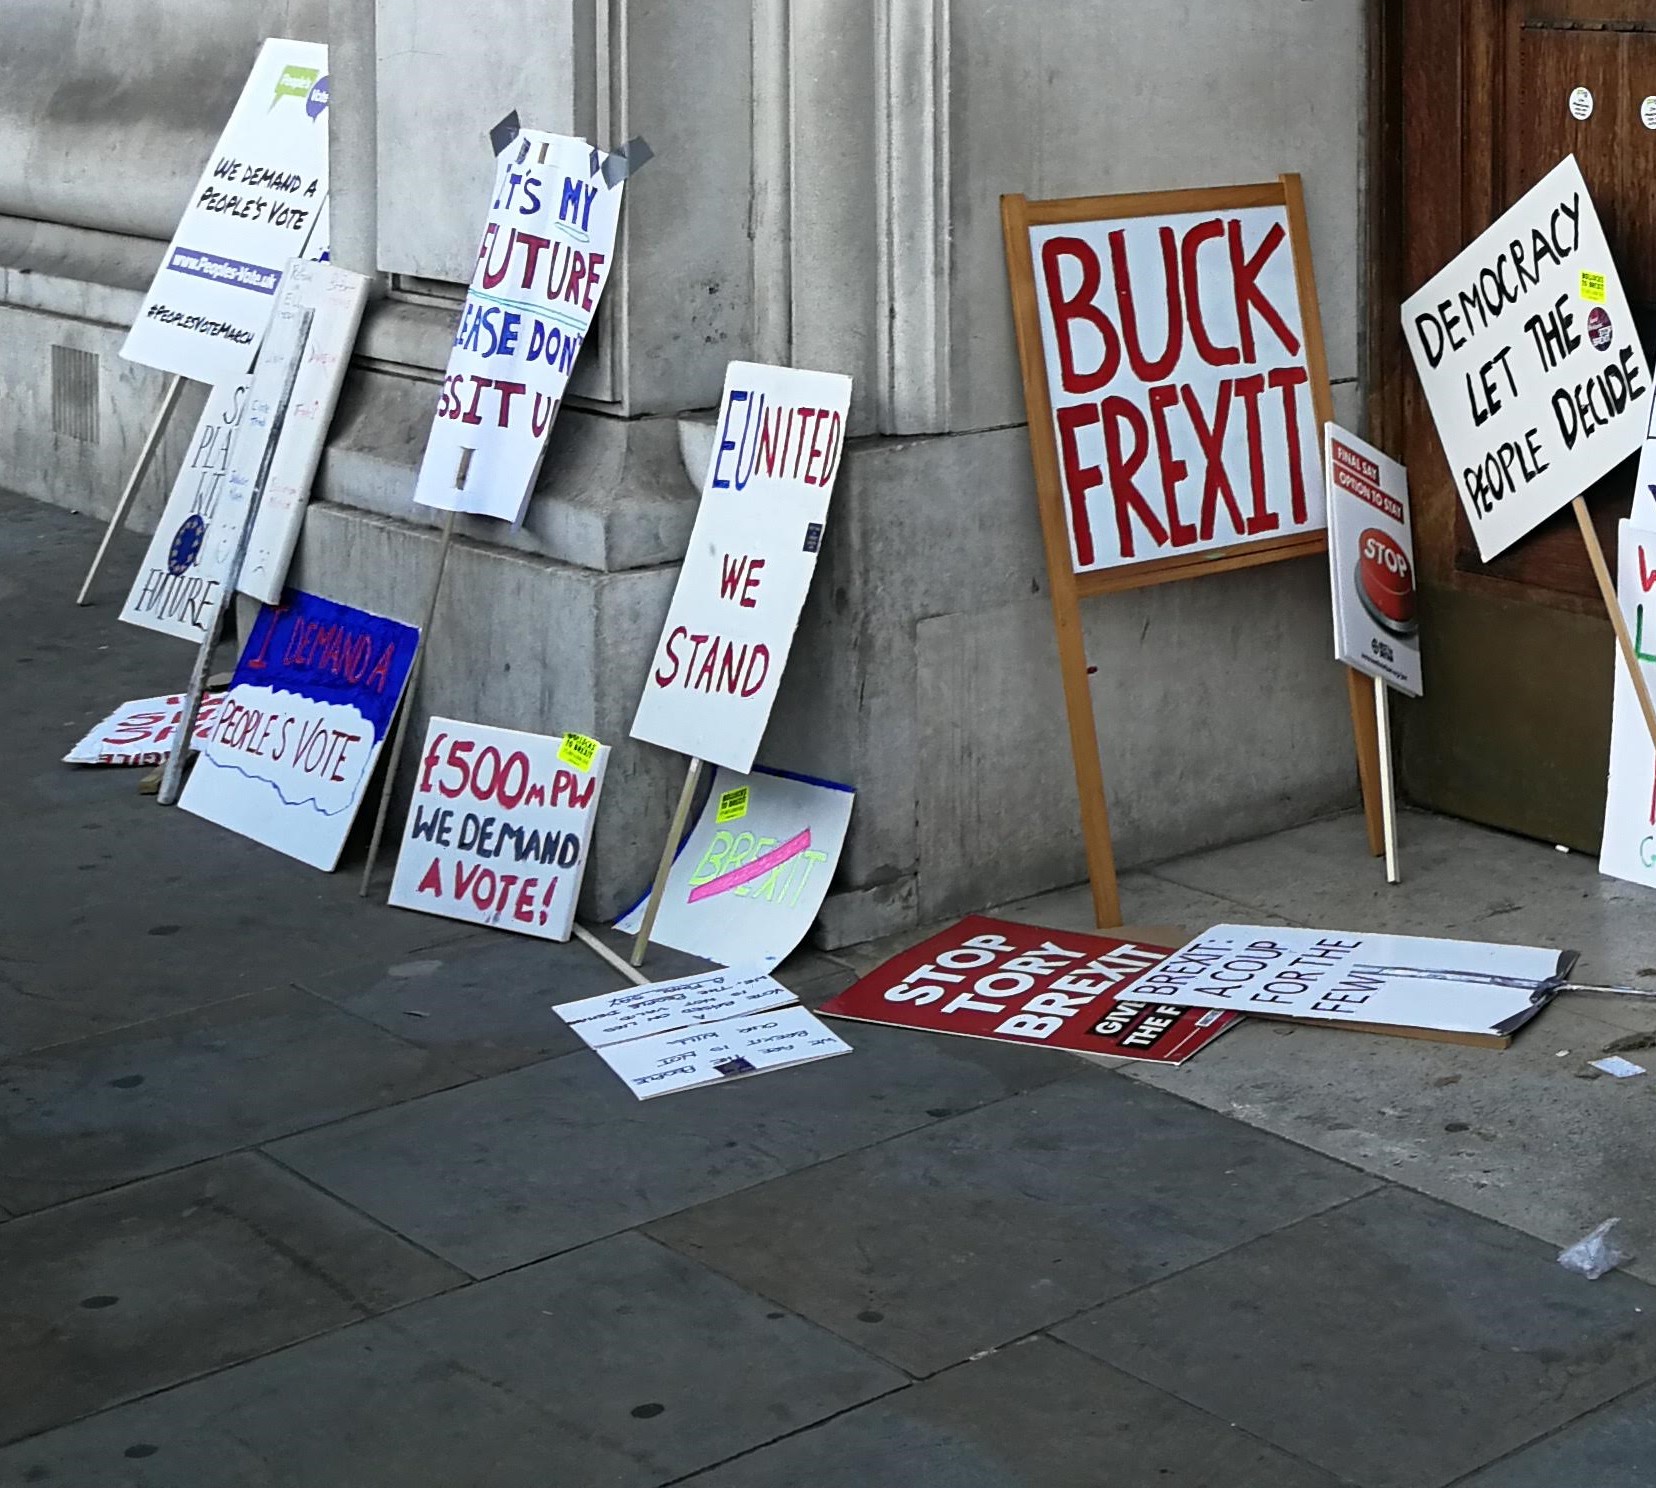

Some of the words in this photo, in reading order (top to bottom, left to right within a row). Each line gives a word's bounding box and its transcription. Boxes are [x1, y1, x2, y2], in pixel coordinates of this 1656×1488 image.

[196, 185, 267, 221] PEOPLE'S
[267, 200, 309, 230] VOTE
[213, 156, 242, 181] WE
[241, 164, 301, 193] DEMAND
[303, 178, 319, 198] A
[493, 163, 542, 215] IT'S
[559, 176, 598, 232] MY
[479, 222, 605, 312] FUTURE
[1415, 192, 1582, 370] DEMOCRACY
[453, 303, 521, 358] EASE
[526, 319, 584, 377] DON'
[1042, 218, 1300, 394] BUCK
[1464, 348, 1519, 428] LET
[1524, 293, 1581, 375] THE
[532, 392, 561, 439] U
[712, 390, 841, 492] EUNITED
[1464, 428, 1549, 519] PEOPLE
[1551, 346, 1648, 451] DECIDE
[1056, 367, 1307, 566] FREXIT
[1338, 446, 1361, 474] FINAL
[1361, 461, 1378, 481] SAY
[1339, 471, 1371, 501] OPTION
[1371, 488, 1383, 508] TO
[1383, 495, 1404, 519] STAY
[721, 553, 766, 609] WE
[1364, 537, 1408, 578] STOP
[248, 606, 288, 669] I
[284, 616, 372, 684] DEMAND
[367, 641, 395, 695] A
[655, 625, 770, 699] STAND
[292, 717, 361, 782] VOTE
[550, 769, 596, 810] PW
[412, 804, 454, 847] WE
[457, 812, 581, 869] DEMAND
[688, 829, 828, 909] BREXIT
[417, 856, 443, 898] A
[454, 859, 559, 927] VOTE!
[884, 934, 1016, 1006] STOP
[941, 941, 1087, 1014] TORY
[994, 944, 1169, 1039] BREXIT
[1133, 939, 1233, 997] BREXIT:
[1194, 983, 1243, 999] A
[1210, 940, 1289, 982] COUP
[1250, 970, 1326, 1005] FOR
[1288, 938, 1363, 967] THE
[1122, 1016, 1173, 1046] THE
